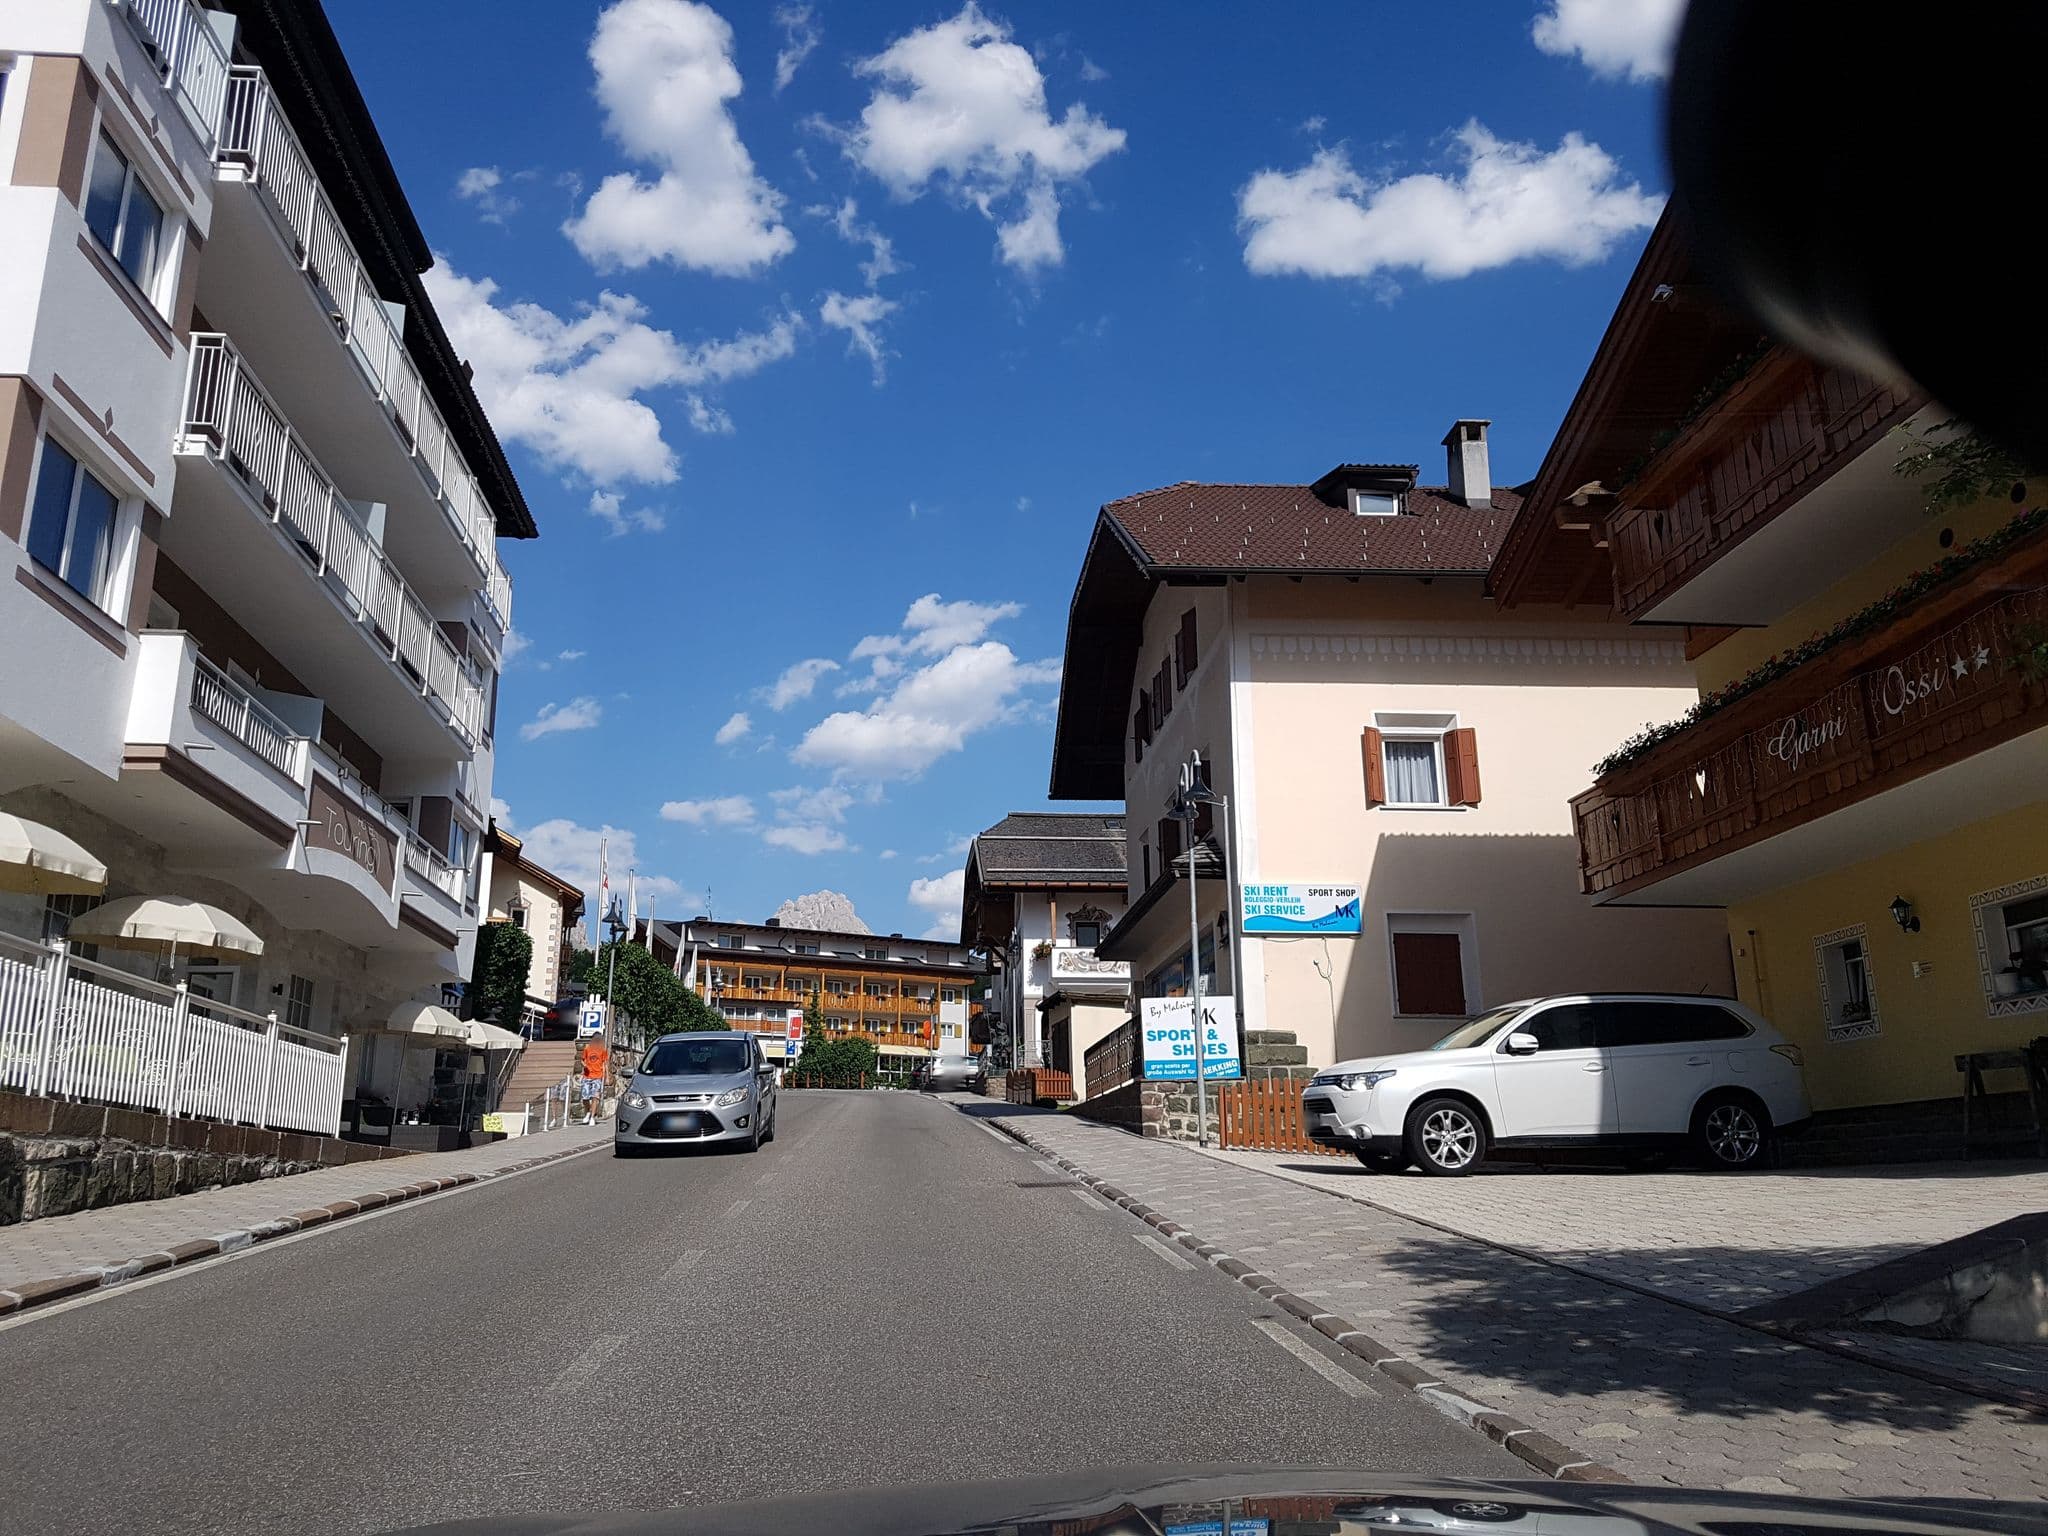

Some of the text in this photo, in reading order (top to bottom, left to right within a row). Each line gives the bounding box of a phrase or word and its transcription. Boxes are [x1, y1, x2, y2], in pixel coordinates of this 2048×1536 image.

[1768, 657, 1946, 771] Garni Ossi
[326, 806, 375, 873] Touring
[1244, 886, 1288, 896] SKI RENT
[1308, 888, 1357, 897] SPORT SHOP
[1245, 904, 1306, 915] SKI SERVICE
[1335, 904, 1356, 918] MK
[1150, 1006, 1161, 1018] By
[585, 1012, 600, 1028] P
[1206, 1028, 1219, 1040] &
